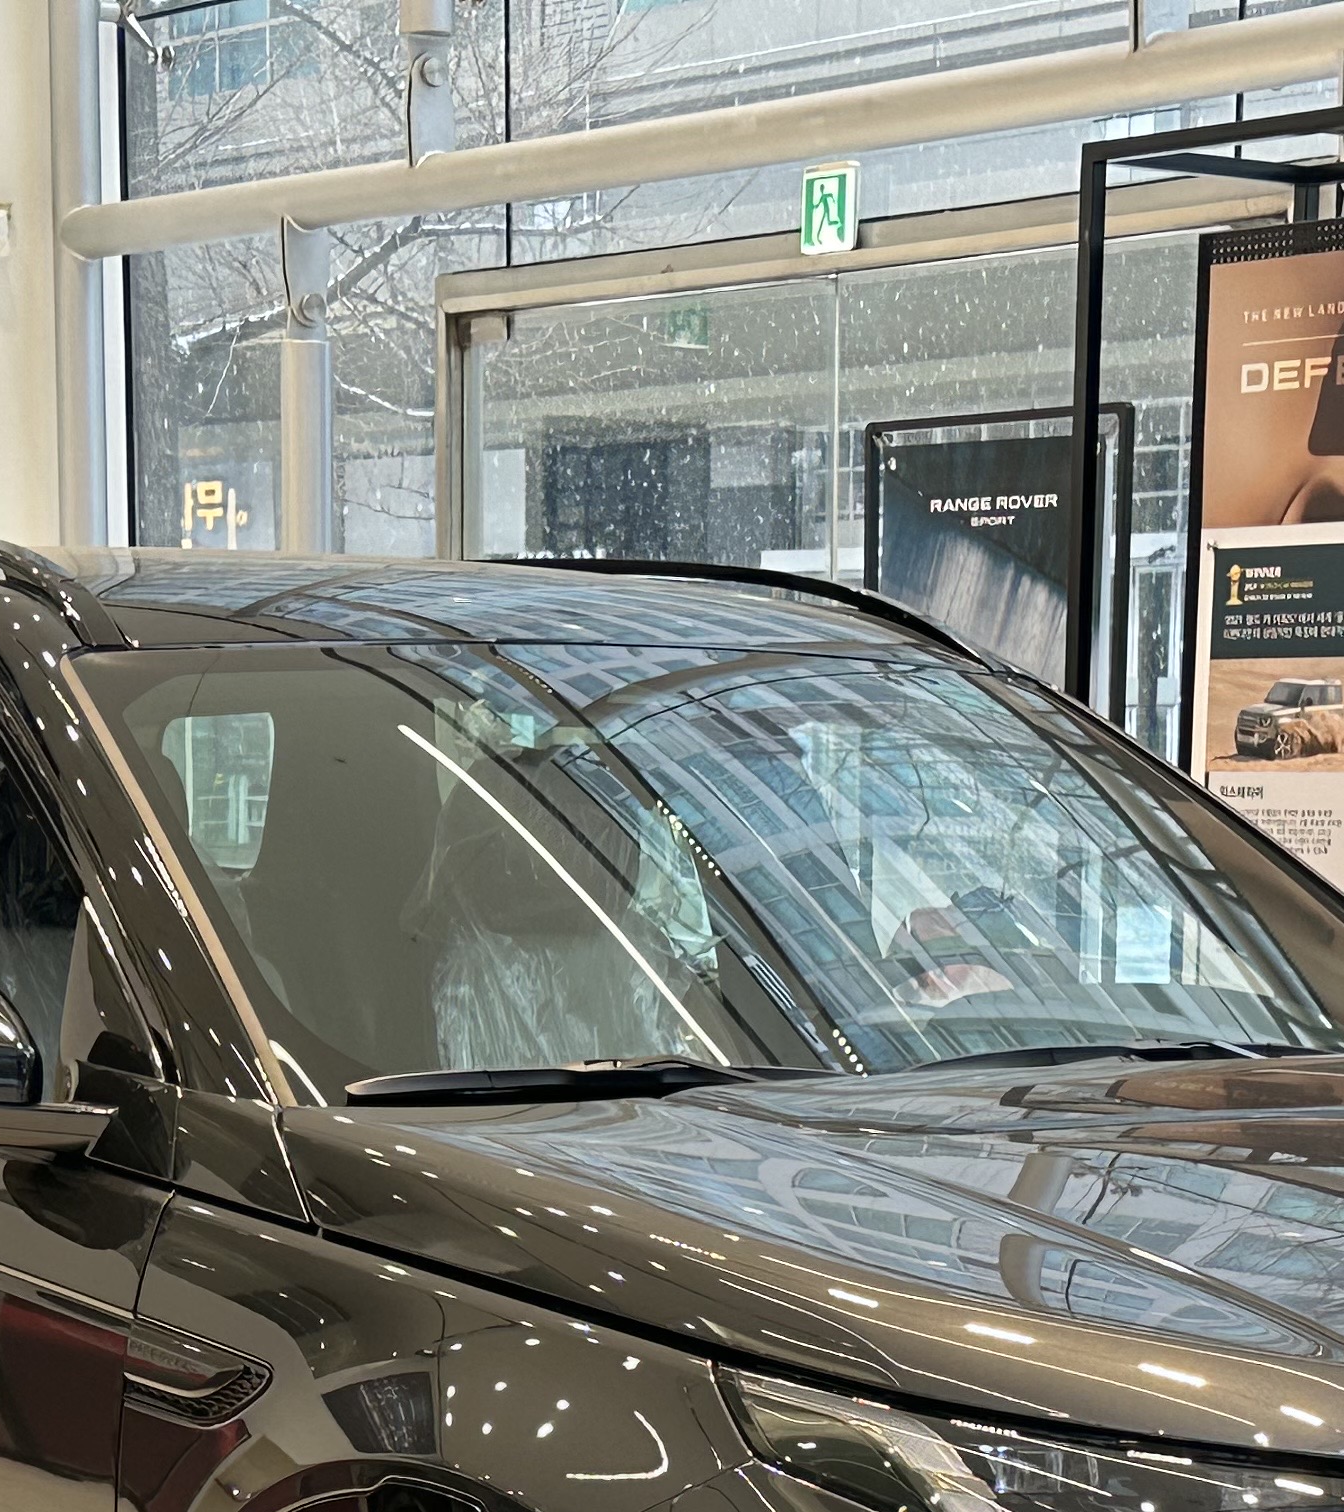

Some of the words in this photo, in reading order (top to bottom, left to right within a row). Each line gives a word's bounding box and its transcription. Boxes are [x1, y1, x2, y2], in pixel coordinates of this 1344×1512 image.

[1243, 309, 1268, 324] THE
[930, 496, 992, 513] RANGE
[996, 493, 1058, 510] ROVER
[970, 515, 1016, 527] SPORT
